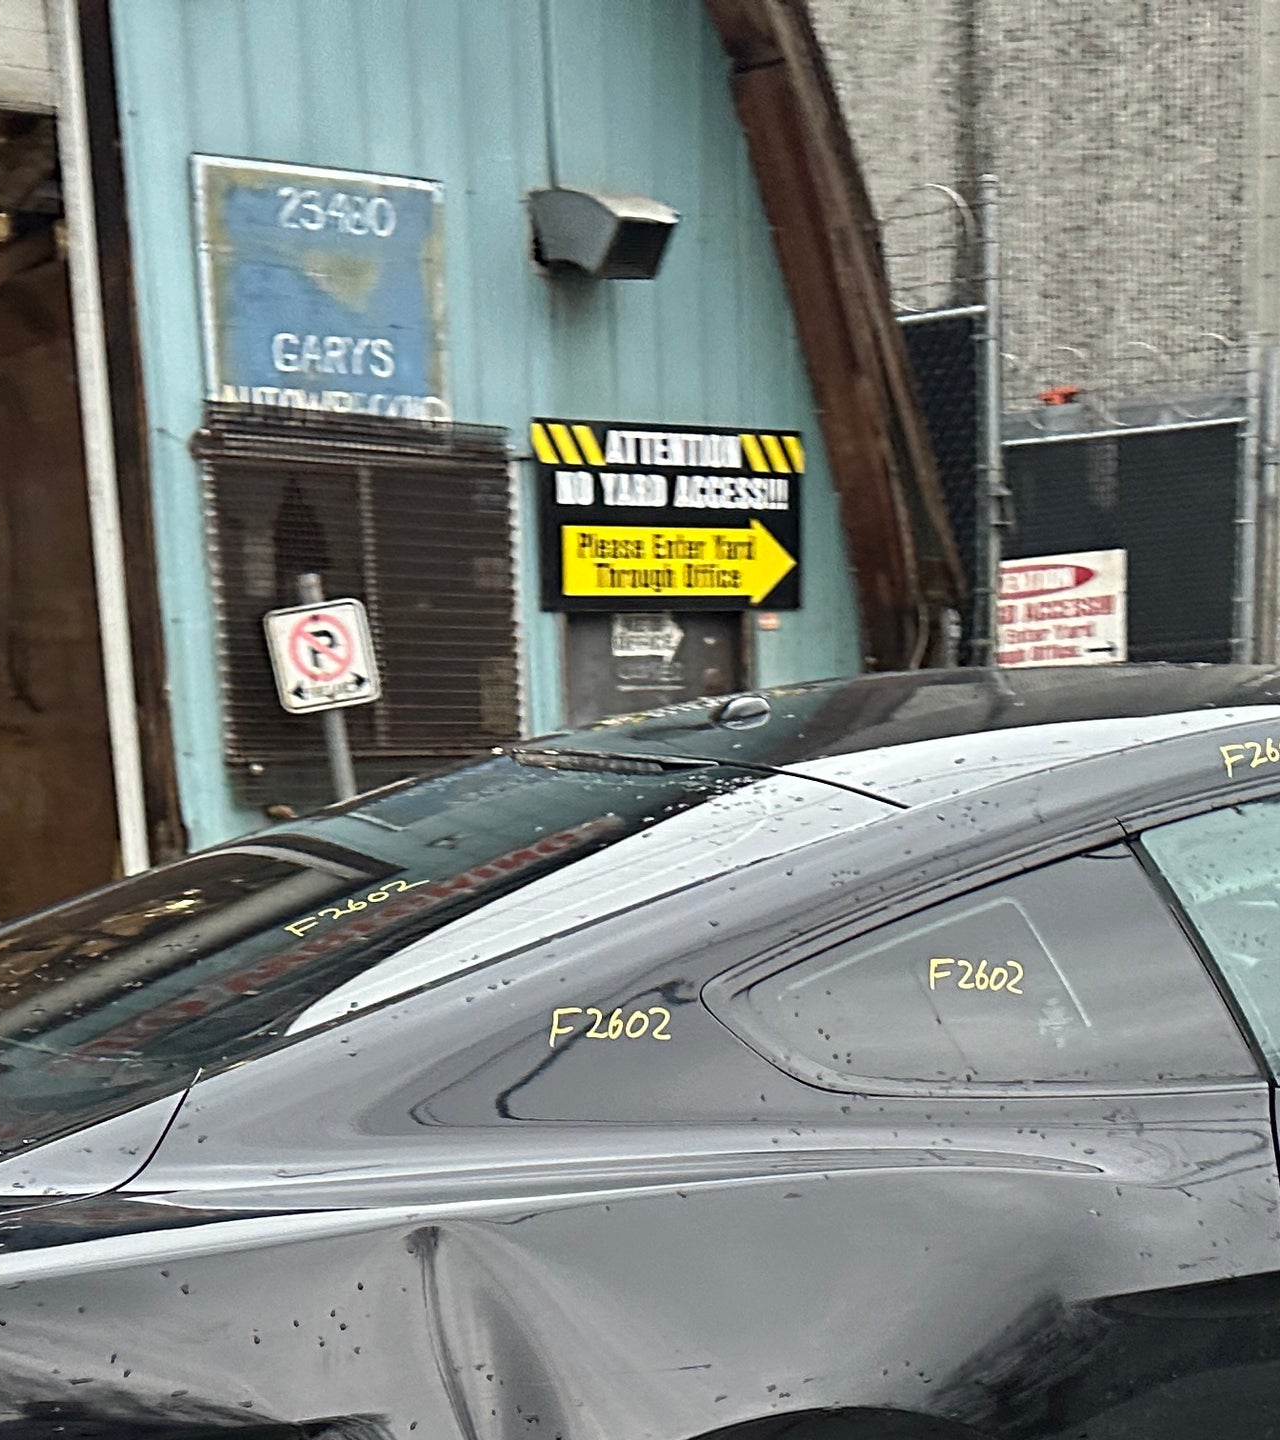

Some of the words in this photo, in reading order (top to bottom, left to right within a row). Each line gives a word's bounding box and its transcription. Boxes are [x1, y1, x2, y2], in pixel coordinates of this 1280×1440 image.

[605, 429, 743, 468] ATTENTION
[555, 470, 595, 505] NO
[598, 473, 669, 507] YARD
[577, 532, 645, 559] Please
[652, 534, 706, 560] Enter
[711, 535, 756, 560] Yard
[594, 562, 676, 592] Through
[682, 563, 742, 589] Office
[284, 877, 431, 938] F2602
[928, 957, 1025, 995] F2602
[549, 1007, 671, 1046] F2602
